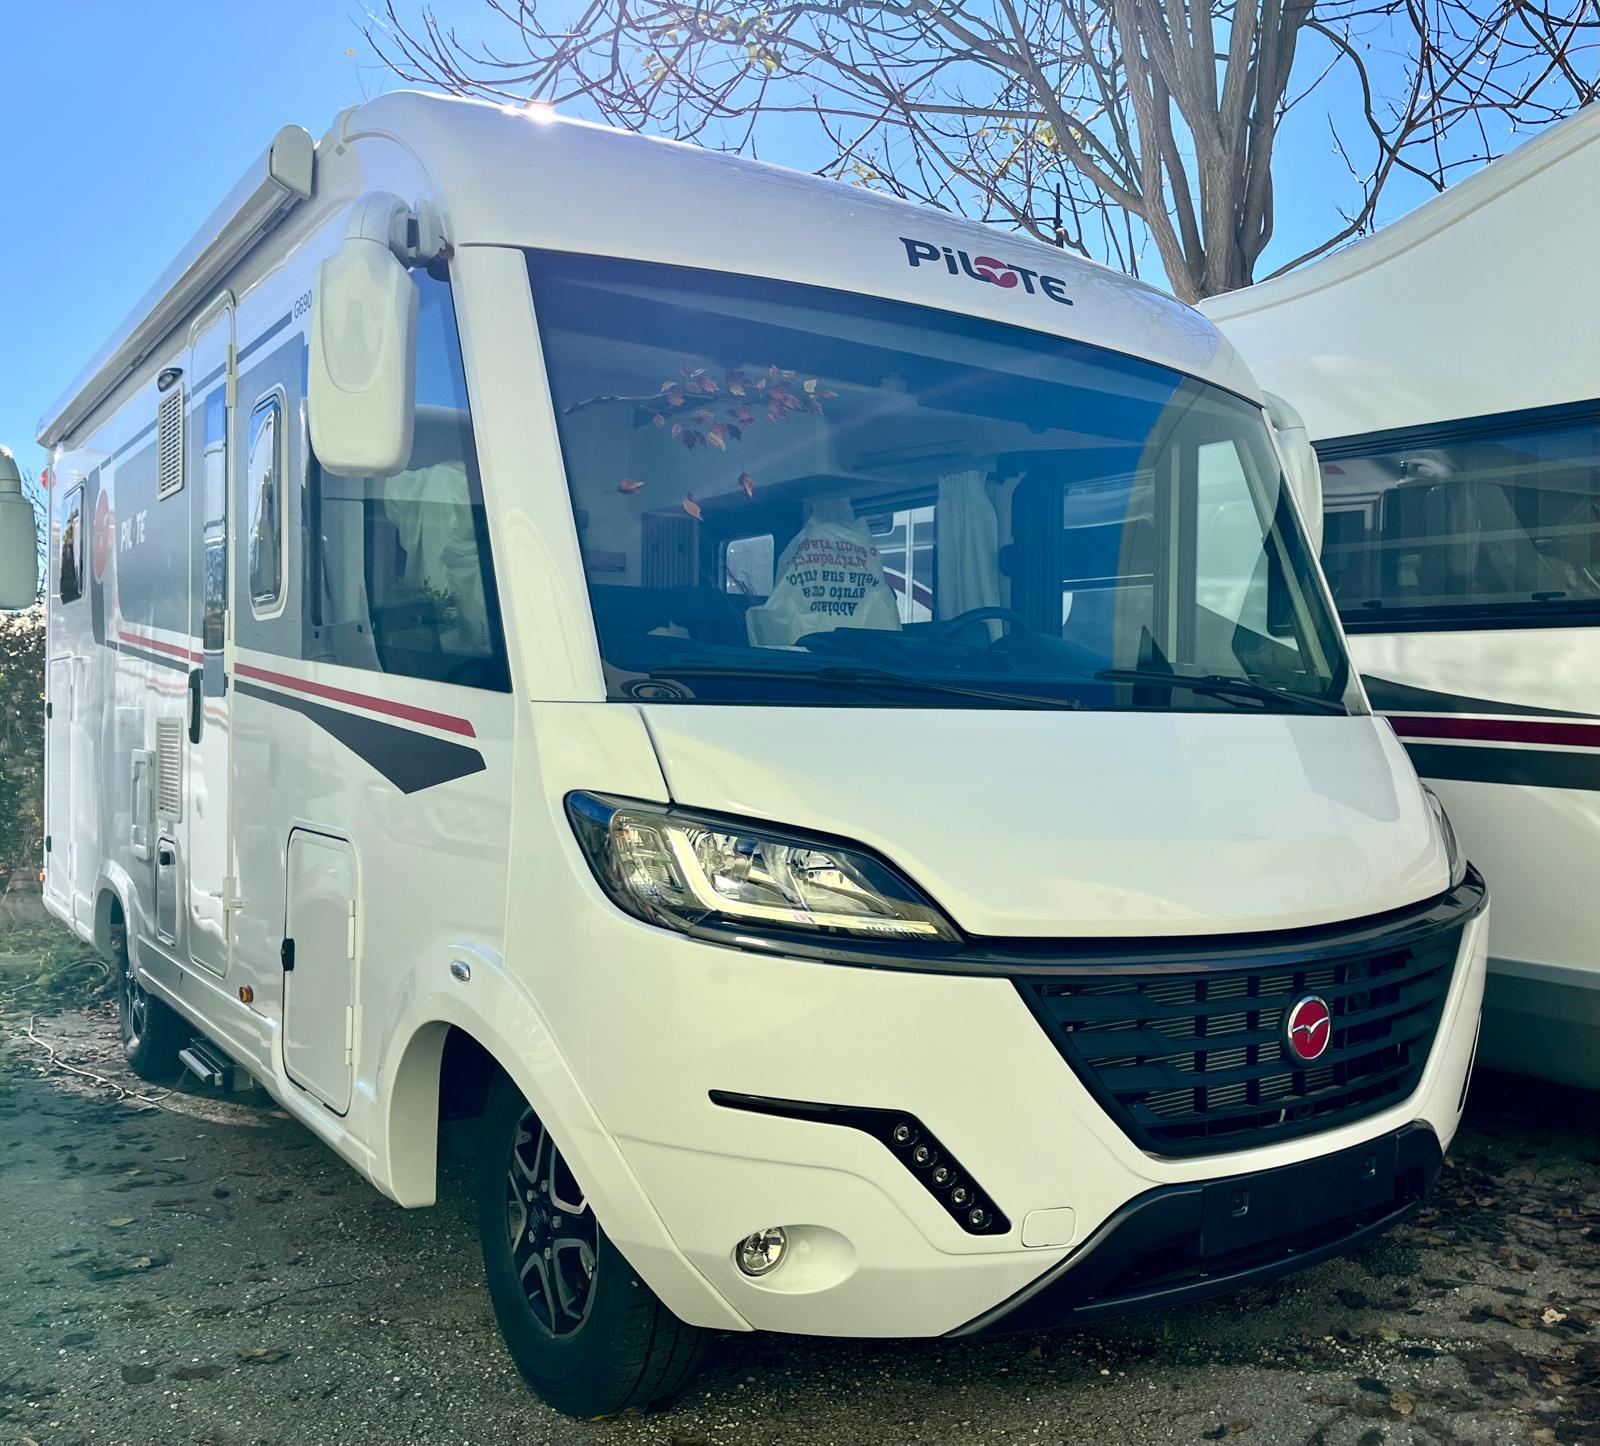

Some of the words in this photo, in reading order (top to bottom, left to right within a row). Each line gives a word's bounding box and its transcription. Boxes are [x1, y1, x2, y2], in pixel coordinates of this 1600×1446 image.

[120, 509, 148, 553] PILTE
[822, 570, 845, 583] sua
[829, 587, 866, 600] avuto
